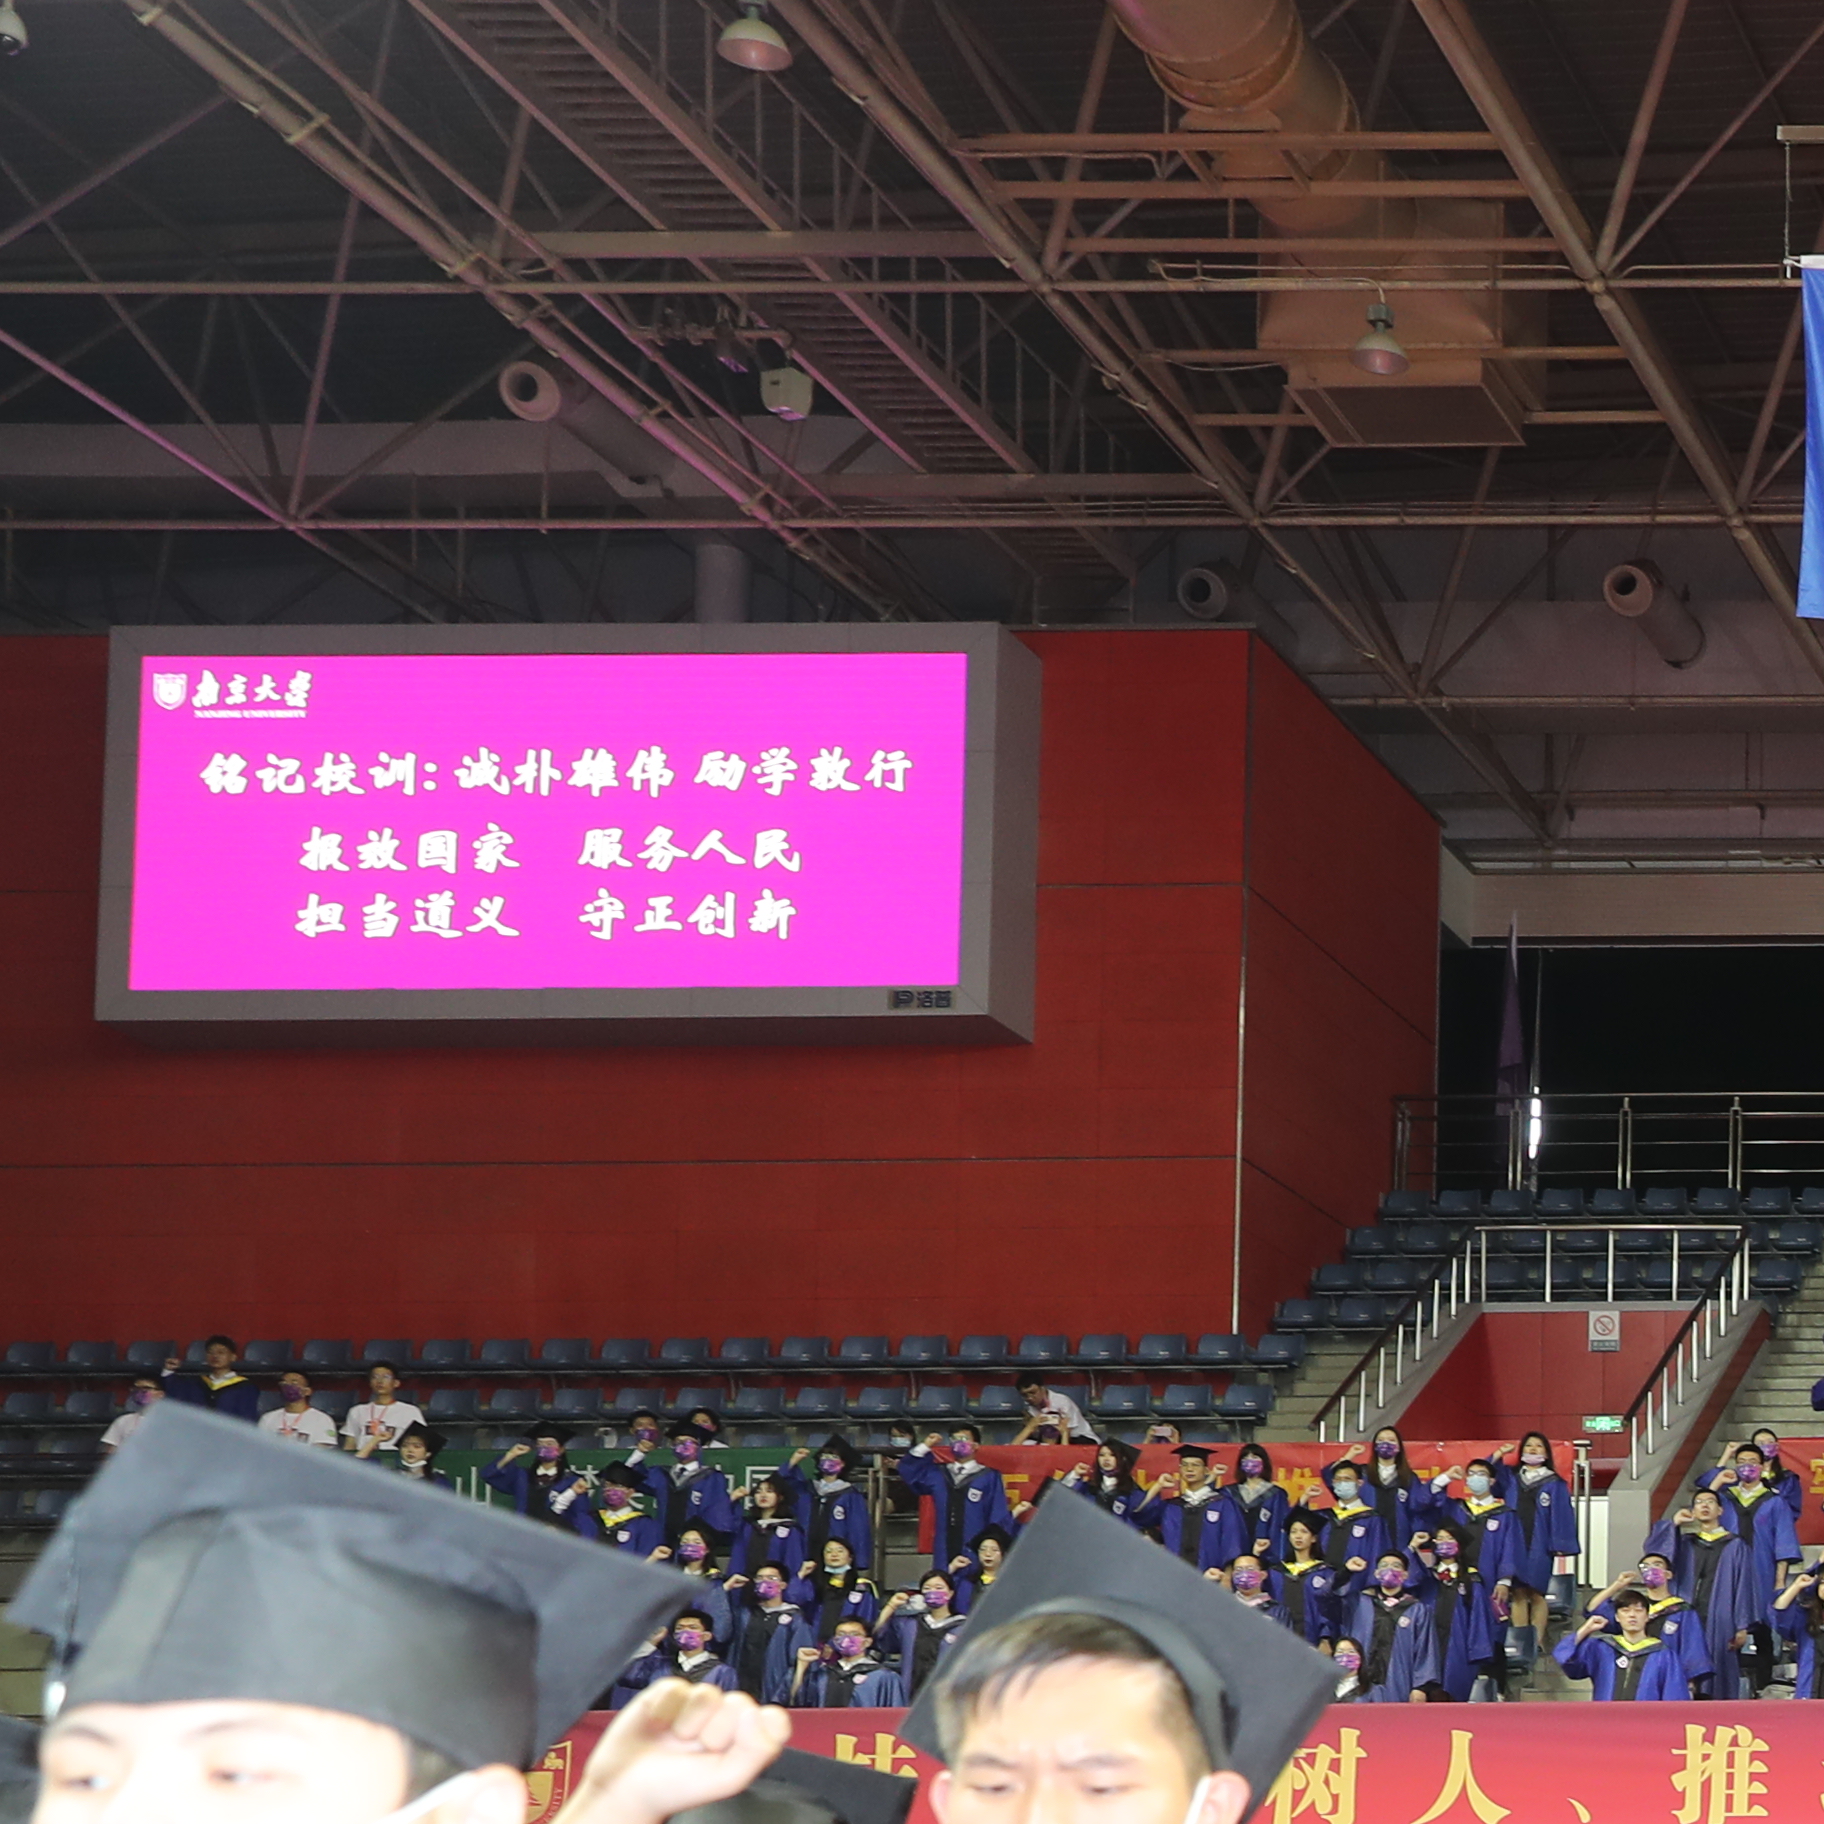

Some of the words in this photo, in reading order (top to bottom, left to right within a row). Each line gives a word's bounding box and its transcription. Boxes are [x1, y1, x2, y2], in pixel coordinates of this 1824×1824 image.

[300, 823, 522, 875] 报效国家
[578, 826, 802, 874] 服务人民
[295, 890, 521, 940] 担当道义
[579, 888, 798, 942] 守正创新
